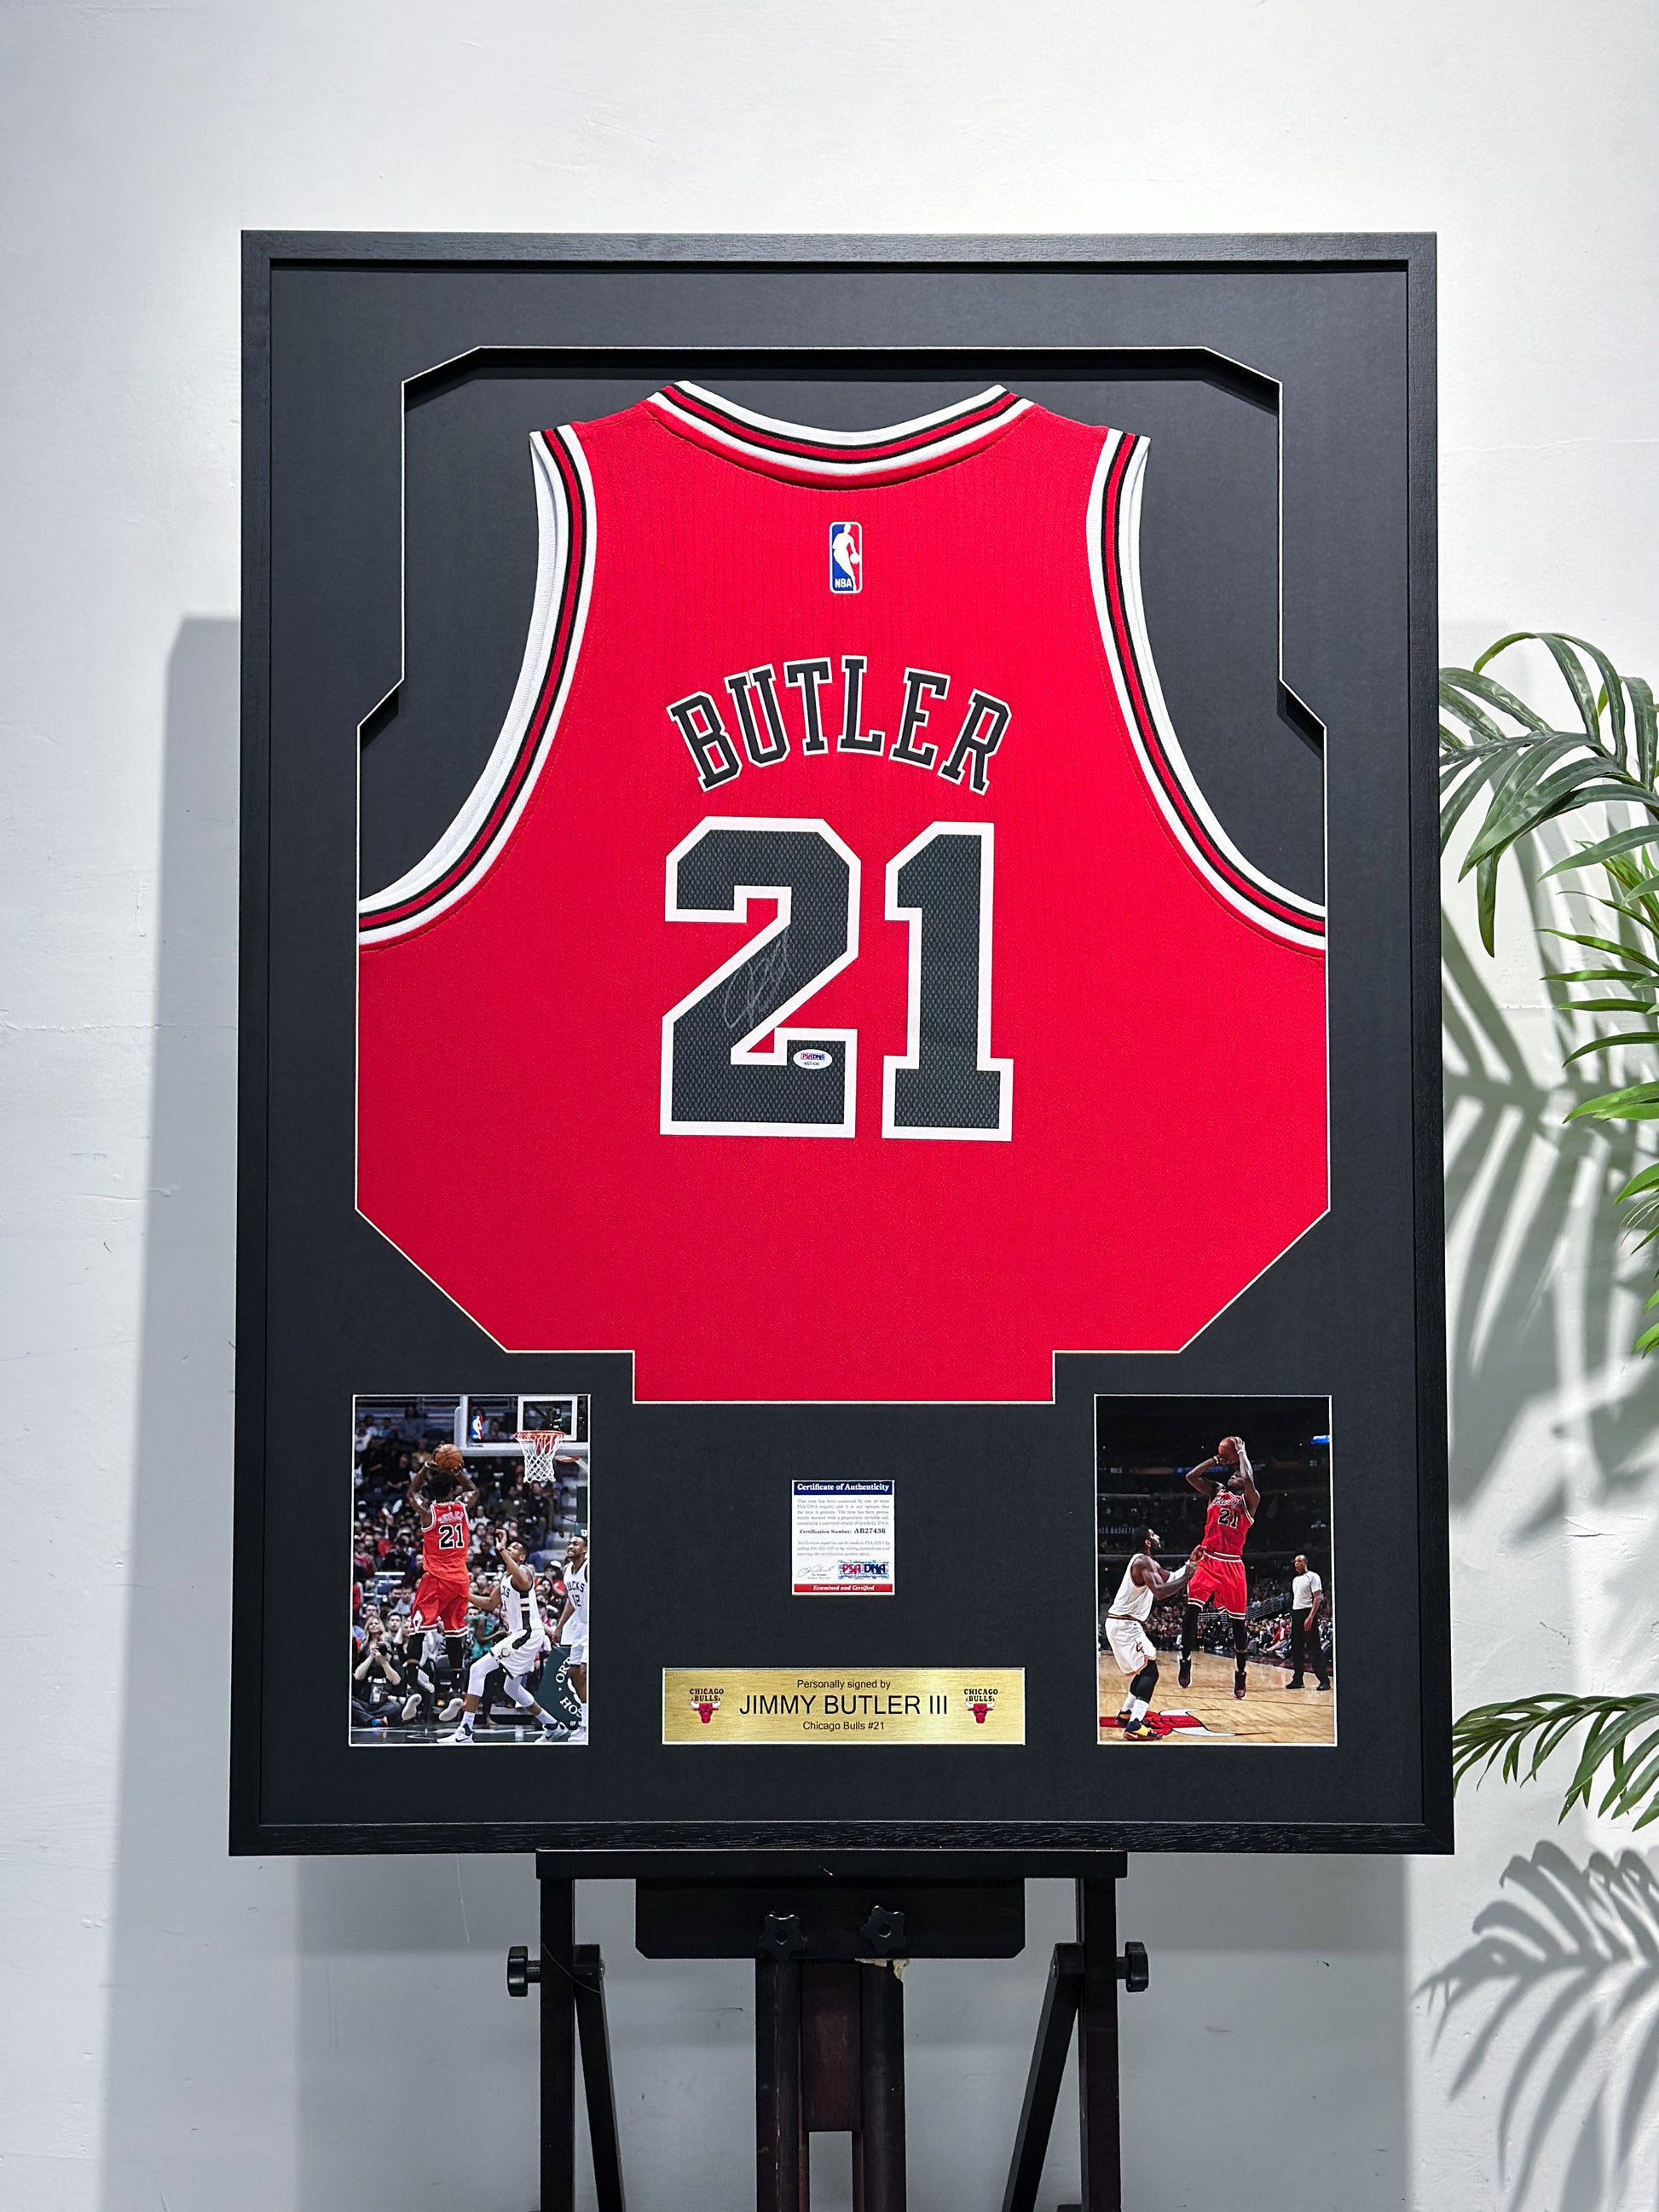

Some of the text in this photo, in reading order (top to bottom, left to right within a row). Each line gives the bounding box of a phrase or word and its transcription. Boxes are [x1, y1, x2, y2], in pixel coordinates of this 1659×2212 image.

[835, 578, 853, 588] NBA
[666, 655, 1012, 796] BUTLER
[660, 816, 1014, 1142] 21
[845, 1483, 889, 1491] Authenticity
[1217, 1508, 1239, 1529] 21
[438, 1523, 465, 1550] 21
[566, 1580, 585, 1593] UCKS
[797, 1679, 891, 1689] Personally signed by
[739, 1694, 947, 1715] JIMMY BUTLER III
[802, 1721, 885, 1732] Chicago Bulls #21
